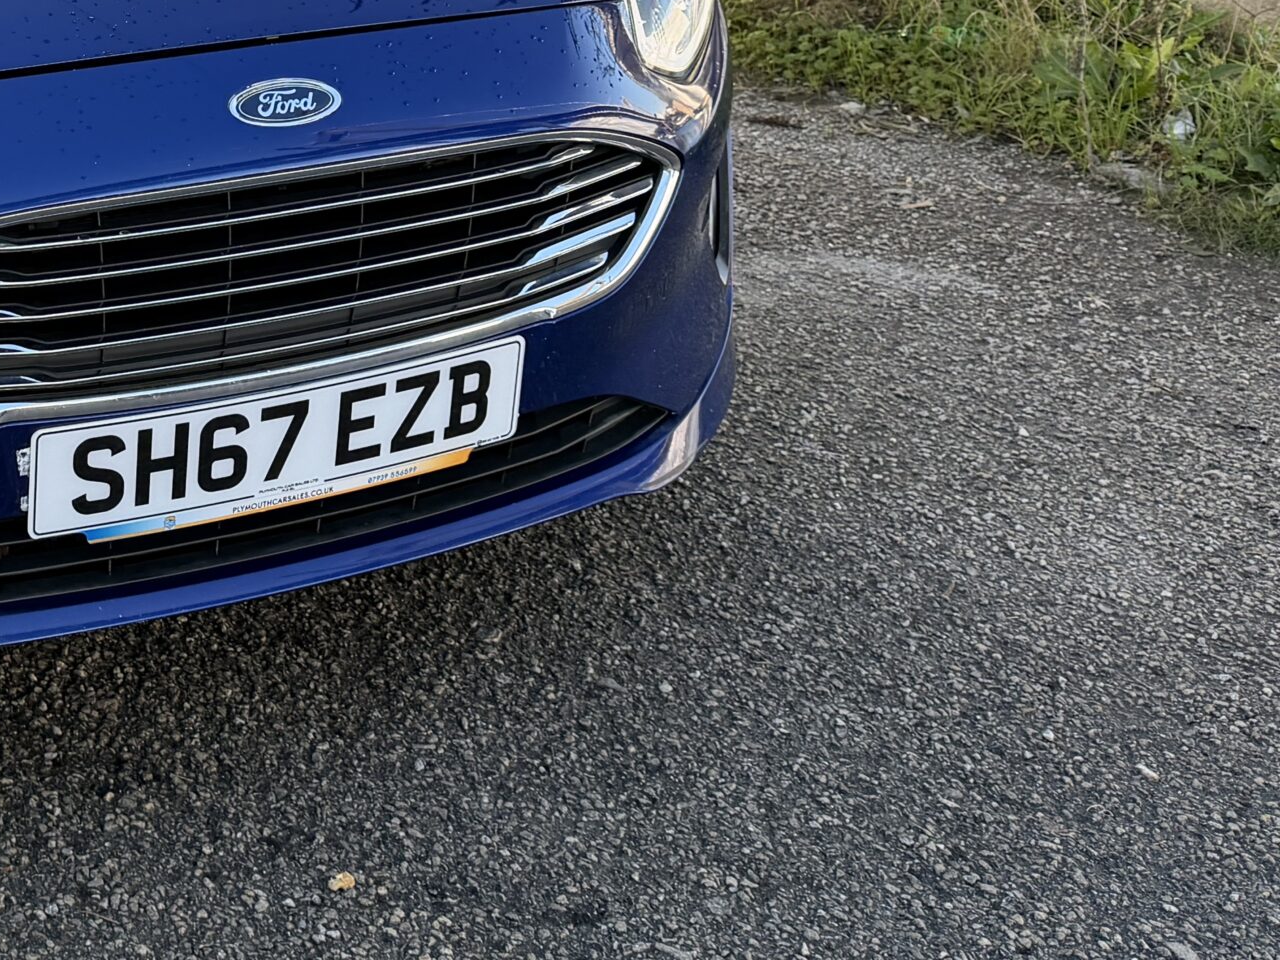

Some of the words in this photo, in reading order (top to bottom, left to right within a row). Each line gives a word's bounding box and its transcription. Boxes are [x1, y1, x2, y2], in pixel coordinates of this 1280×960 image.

[257, 88, 317, 117] Ford
[70, 399, 310, 515] SH67
[335, 360, 491, 467] EZB
[232, 486, 334, 514] PLYMOUTHCARSALES.CO.UK
